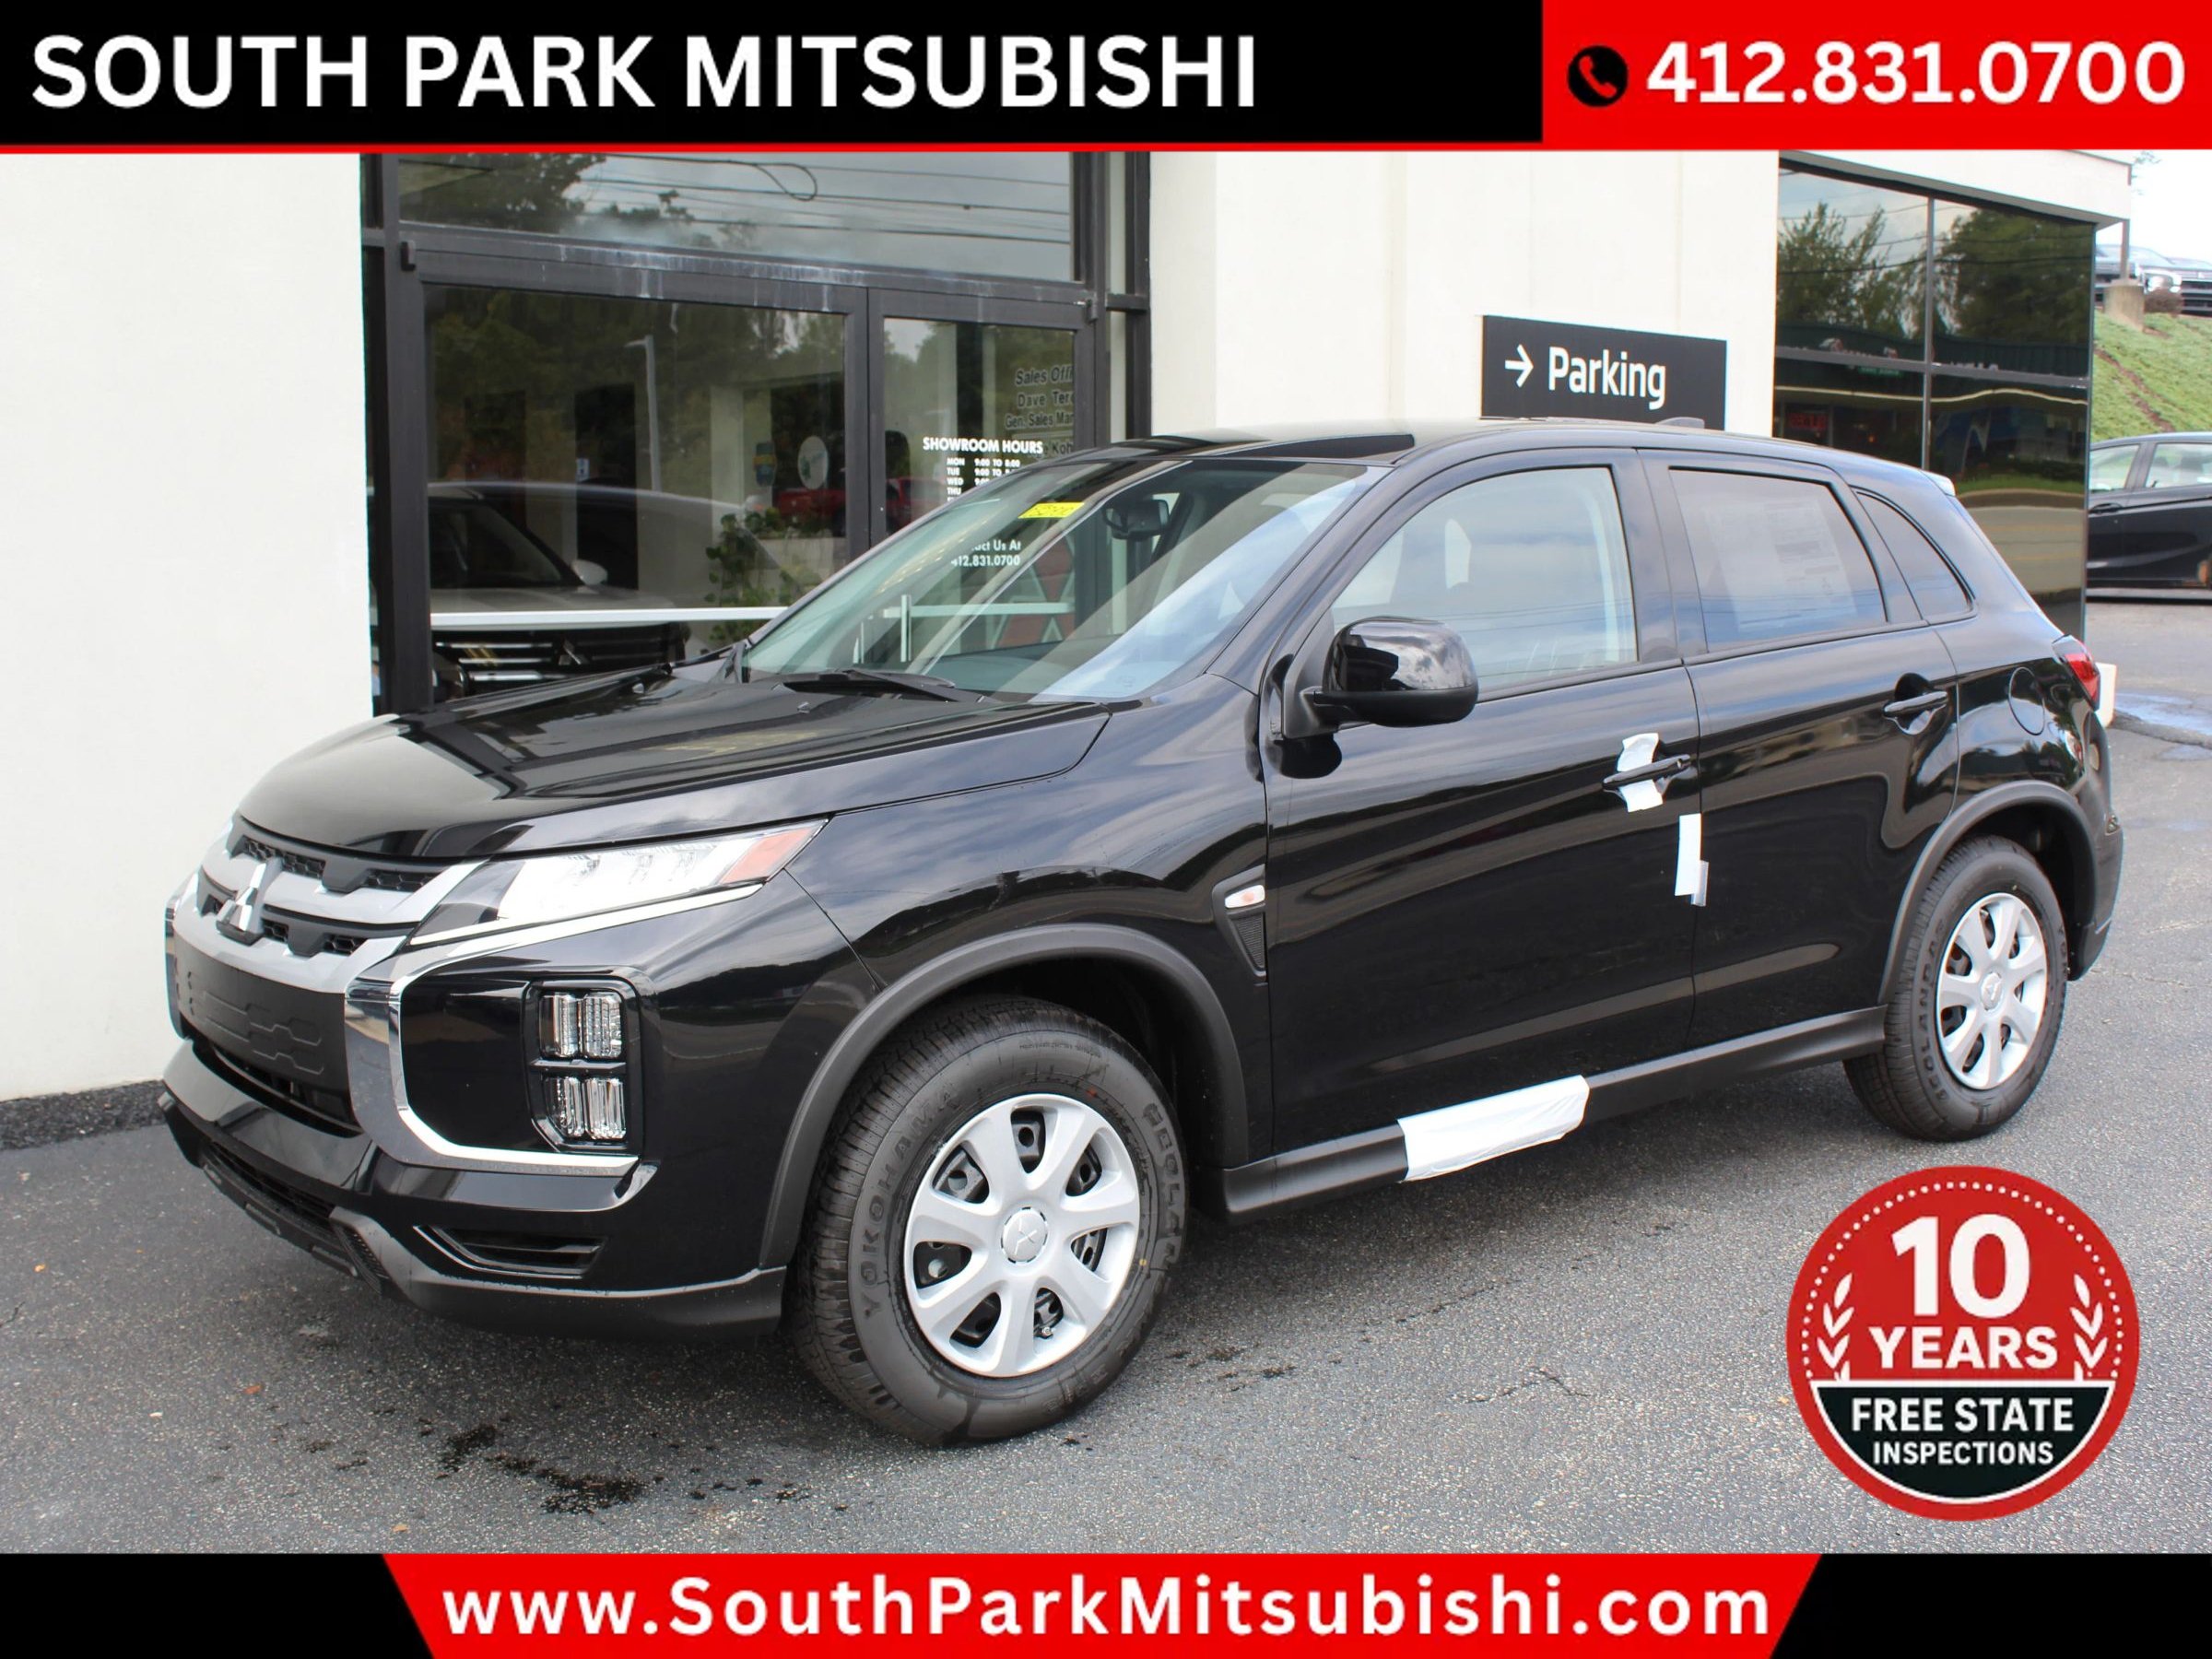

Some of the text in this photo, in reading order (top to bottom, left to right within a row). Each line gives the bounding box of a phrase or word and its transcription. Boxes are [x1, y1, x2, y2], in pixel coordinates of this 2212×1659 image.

[1015, 369, 1047, 385] Sales
[1548, 346, 1666, 410] Parking
[1017, 393, 1046, 407] Dave
[1028, 412, 1053, 427] Sales
[923, 437, 1000, 453] SHOWROOM
[1002, 440, 1043, 454] HOURS
[947, 457, 965, 466] MON
[993, 459, 1003, 467] TO
[947, 467, 960, 476] TUE
[993, 468, 1002, 477] TO
[947, 477, 964, 486] WED
[947, 488, 961, 496] THU
[994, 539, 1006, 551] Us
[1009, 539, 1021, 551] At
[951, 554, 1020, 567] 412.831.0700
[859, 1086, 959, 1319] YOKOHAMA
